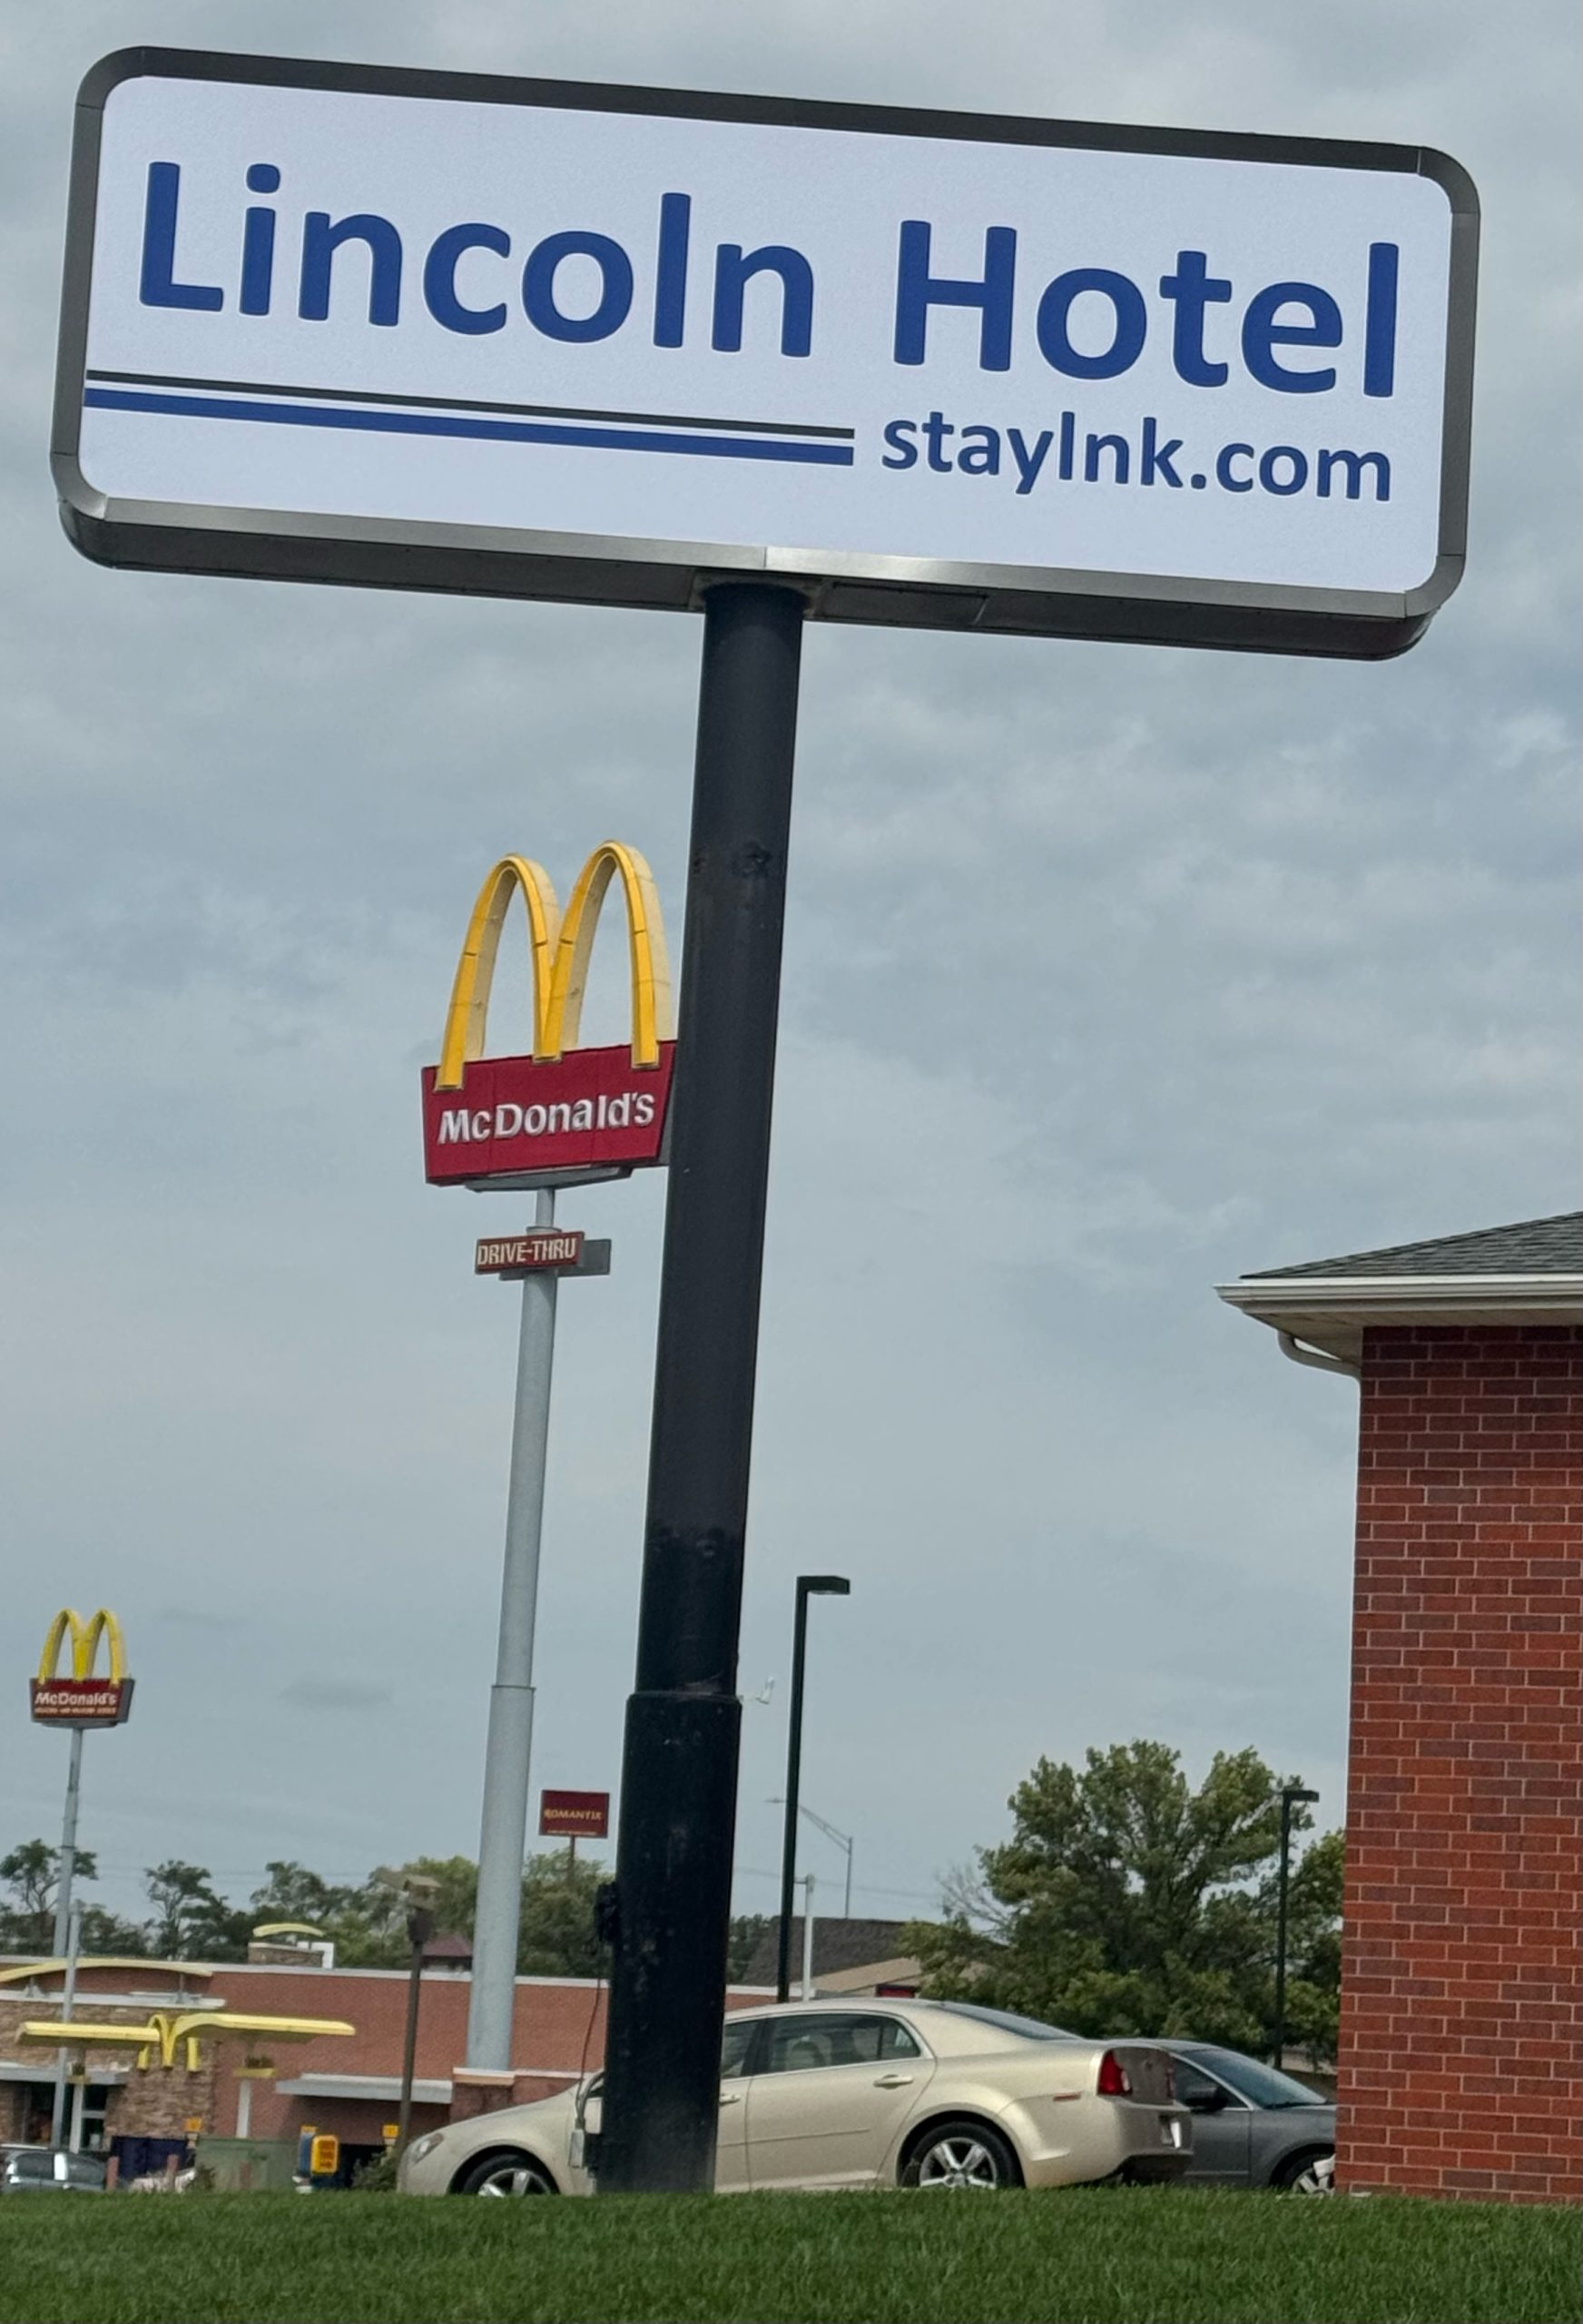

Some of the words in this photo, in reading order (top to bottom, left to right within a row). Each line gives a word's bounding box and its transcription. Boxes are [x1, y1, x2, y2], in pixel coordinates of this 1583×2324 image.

[138, 161, 815, 359] Lincoln
[893, 219, 1400, 398] Hotel
[438, 1091, 655, 1146] McDonald's
[477, 1236, 578, 1266] DRIVE-THRU
[34, 1691, 117, 1706] McDonald's
